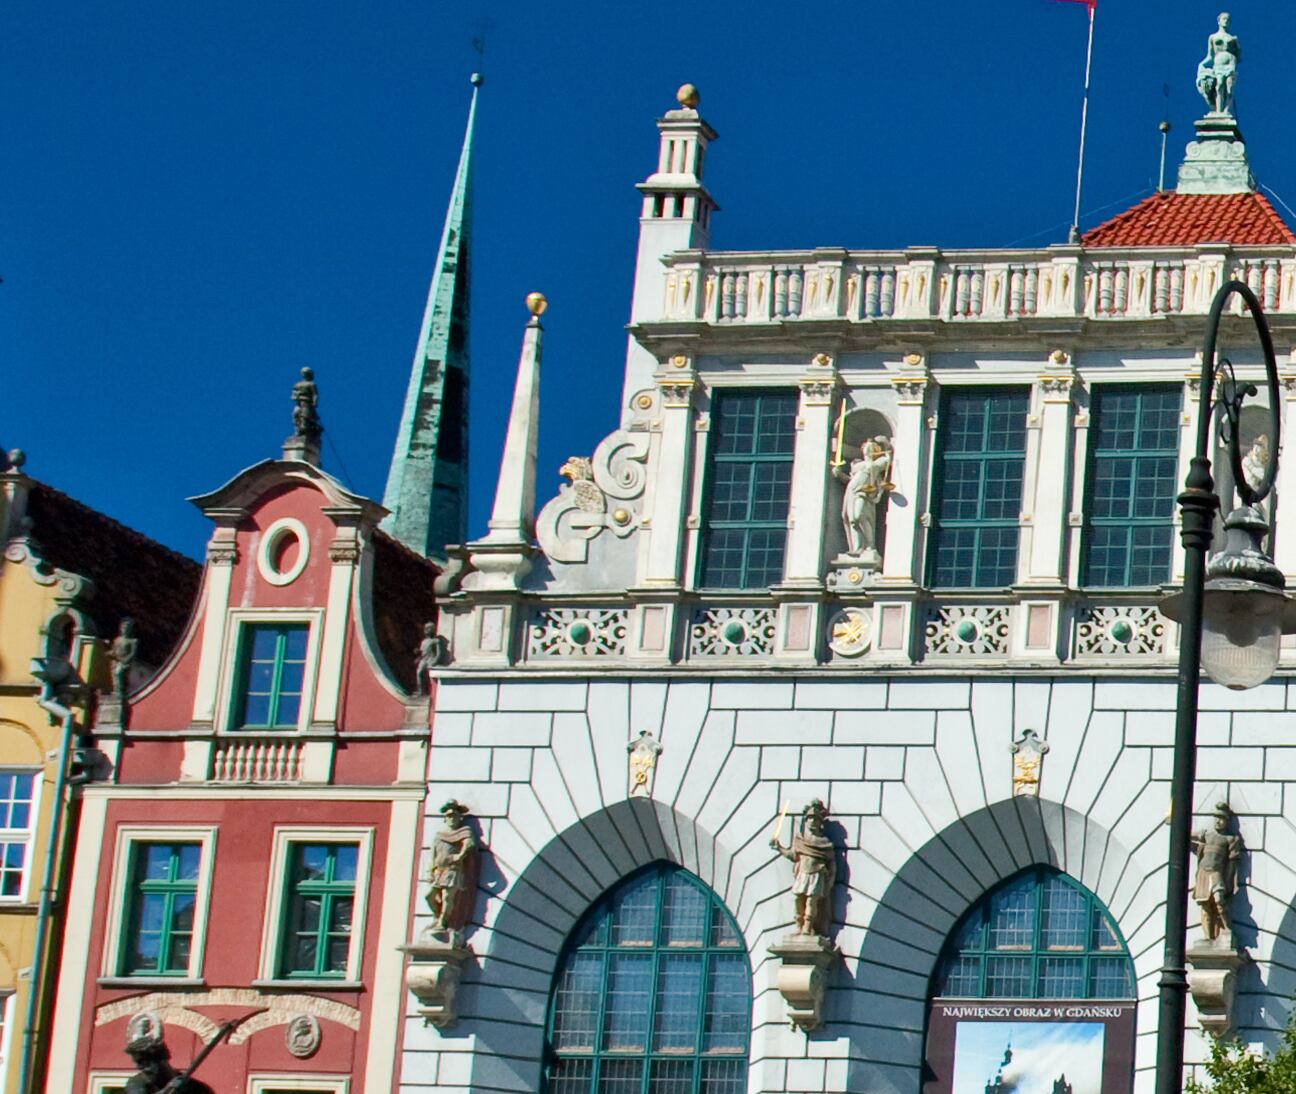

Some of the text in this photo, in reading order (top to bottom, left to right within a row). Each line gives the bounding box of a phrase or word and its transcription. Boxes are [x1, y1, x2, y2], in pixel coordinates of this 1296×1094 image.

[942, 1005, 1123, 1019] NAJWIĘKSZY OBRAZ W GDAŃSKU
